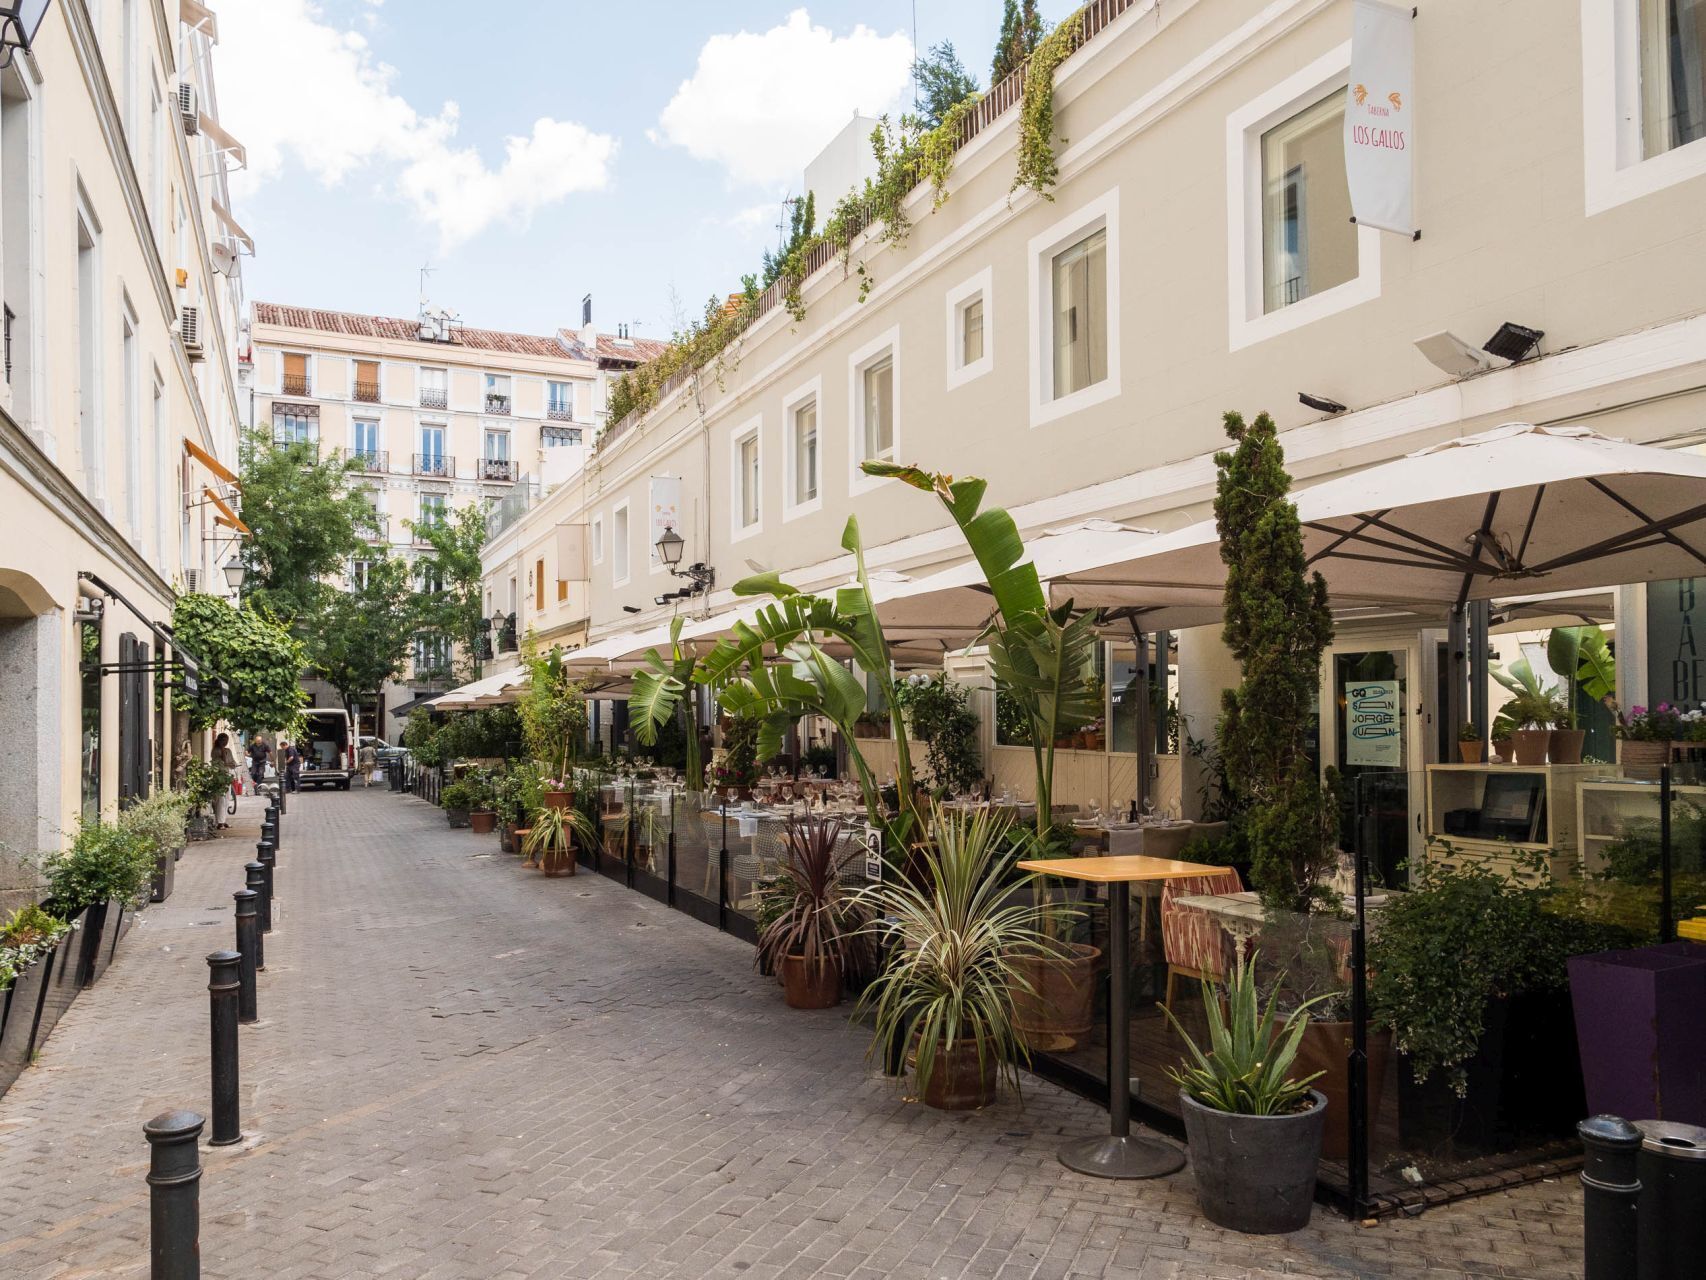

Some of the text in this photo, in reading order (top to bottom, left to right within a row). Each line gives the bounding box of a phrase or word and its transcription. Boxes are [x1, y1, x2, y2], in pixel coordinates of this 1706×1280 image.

[1367, 103, 1390, 117] TABERNA
[1353, 125, 1405, 151] LOS GALLOS
